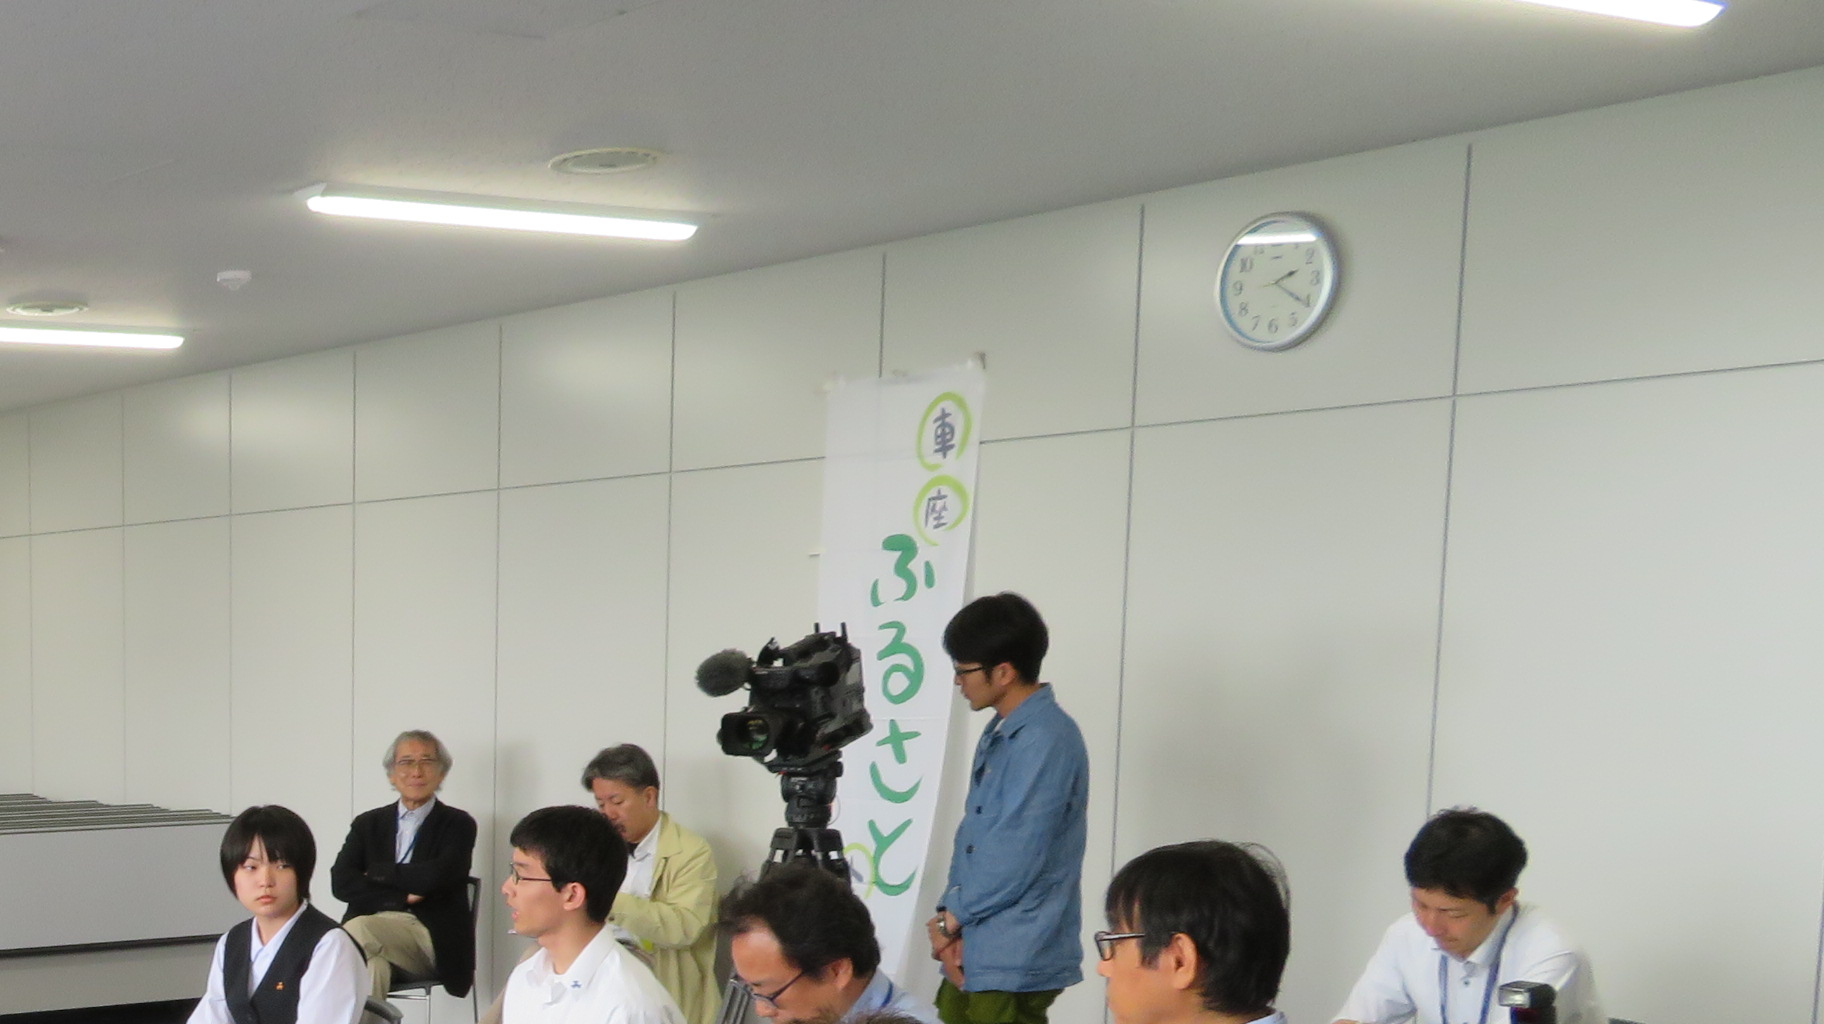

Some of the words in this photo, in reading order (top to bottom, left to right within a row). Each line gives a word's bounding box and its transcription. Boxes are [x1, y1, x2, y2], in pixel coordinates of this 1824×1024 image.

[924, 407, 957, 531] 車座
[868, 533, 936, 897] ふるさと
